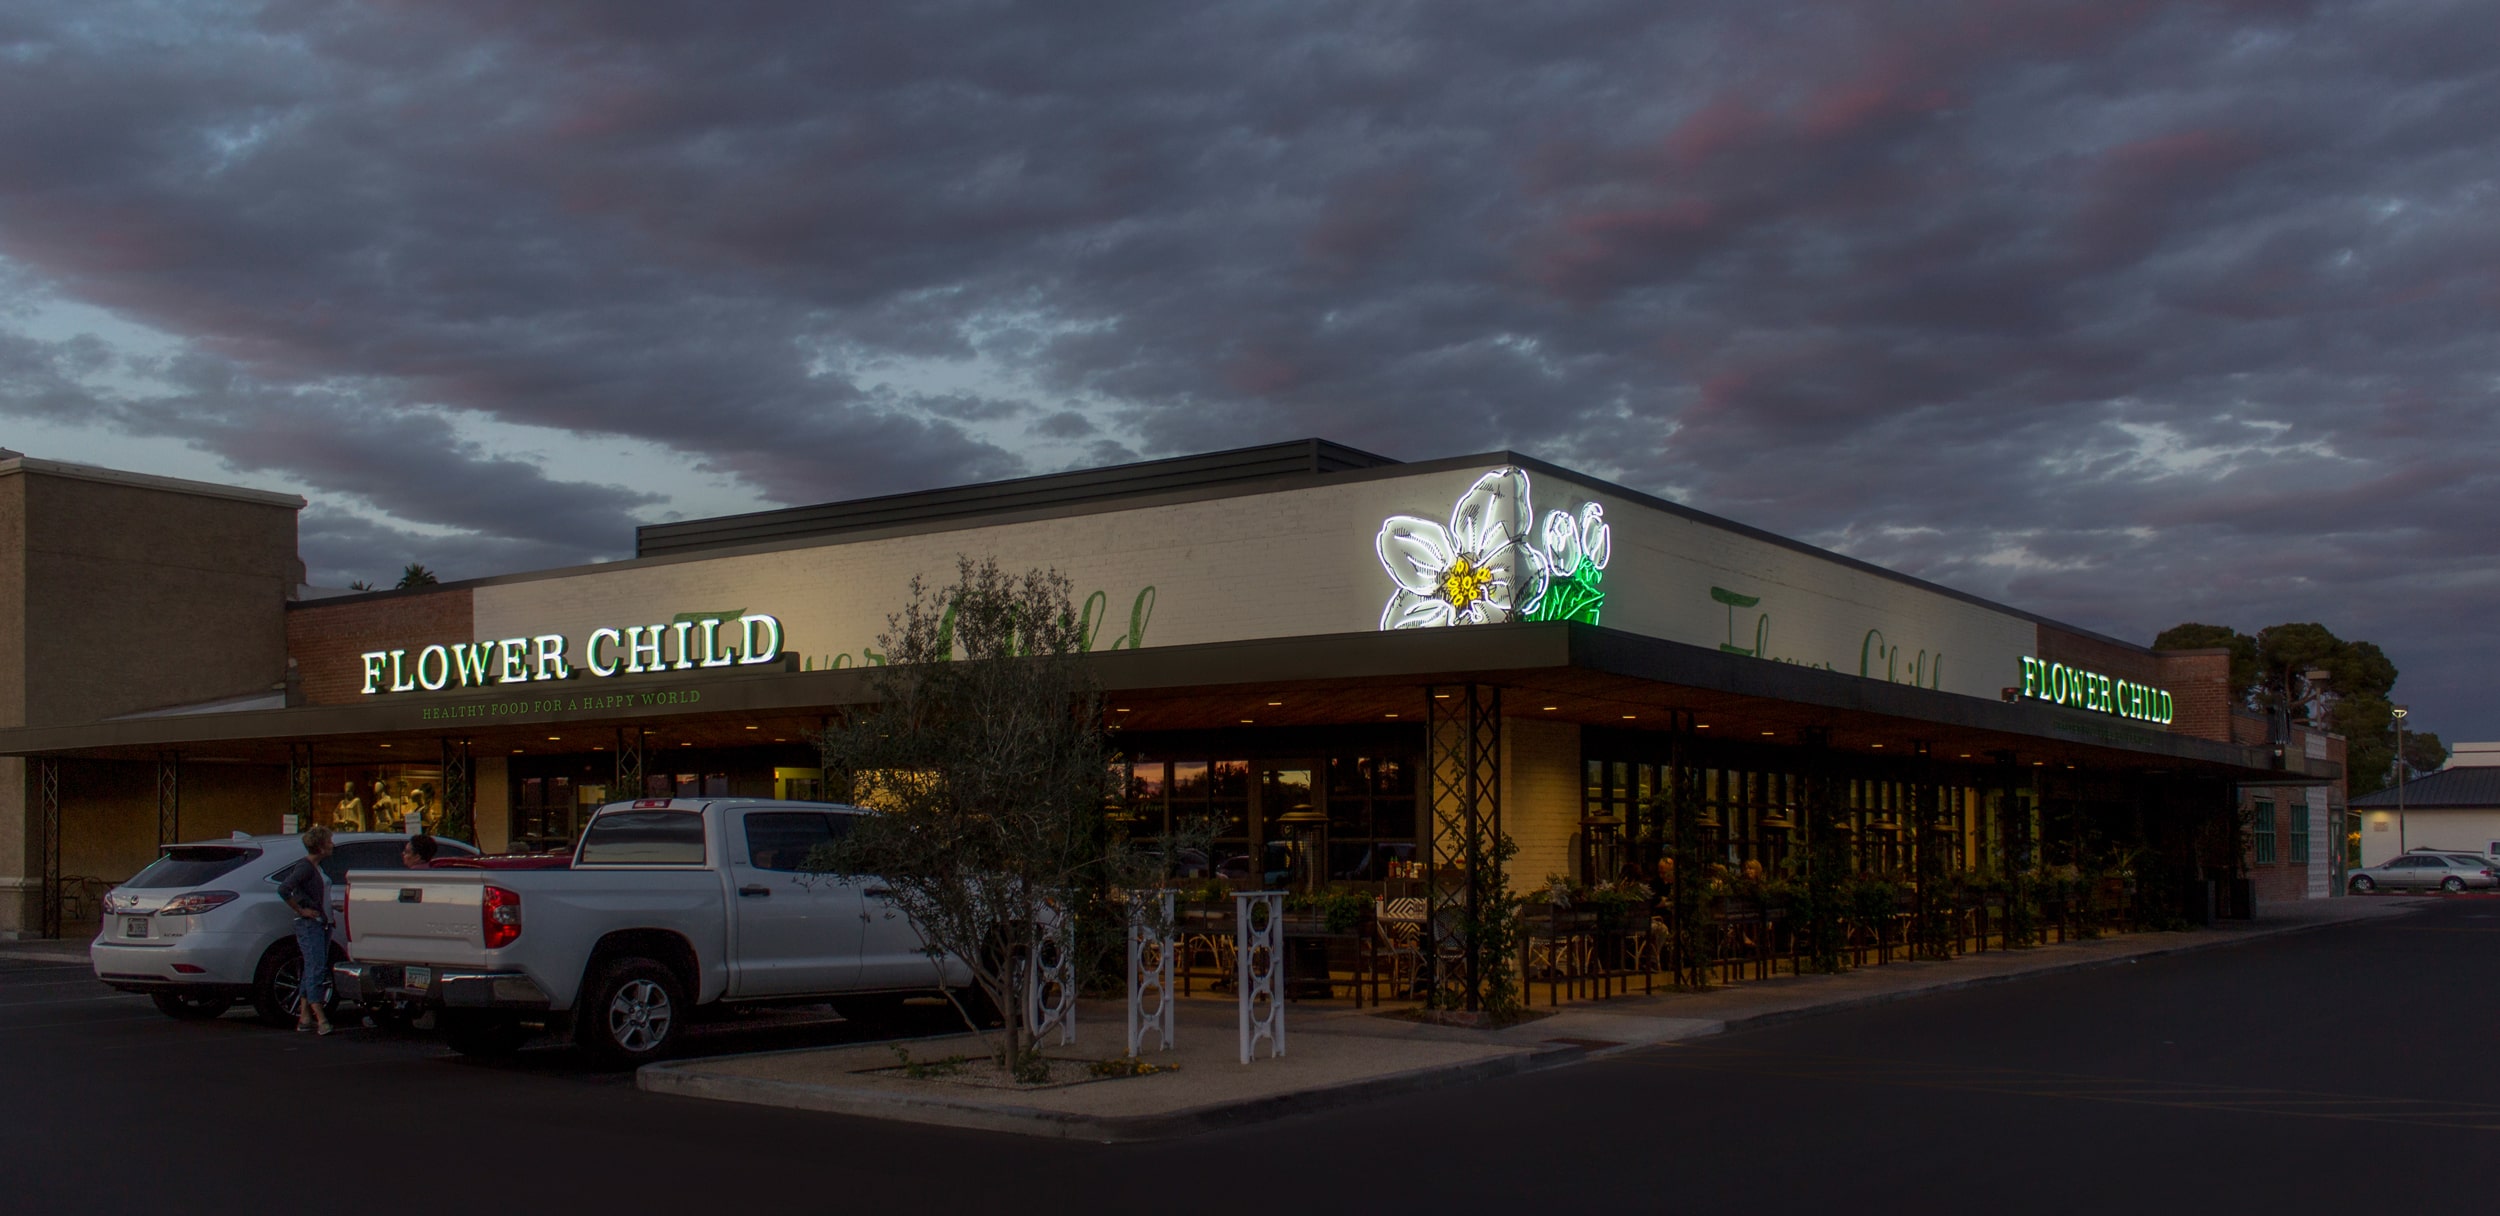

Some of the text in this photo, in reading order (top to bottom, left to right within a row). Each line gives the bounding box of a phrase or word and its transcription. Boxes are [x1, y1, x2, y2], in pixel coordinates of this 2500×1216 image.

[360, 633, 569, 695] FLOWER
[586, 613, 780, 677] CHILD
[422, 689, 702, 720] HEALTHY FOOD FOR A HAPPY WORLD
[2021, 655, 2174, 726] FLOWER CHILD
